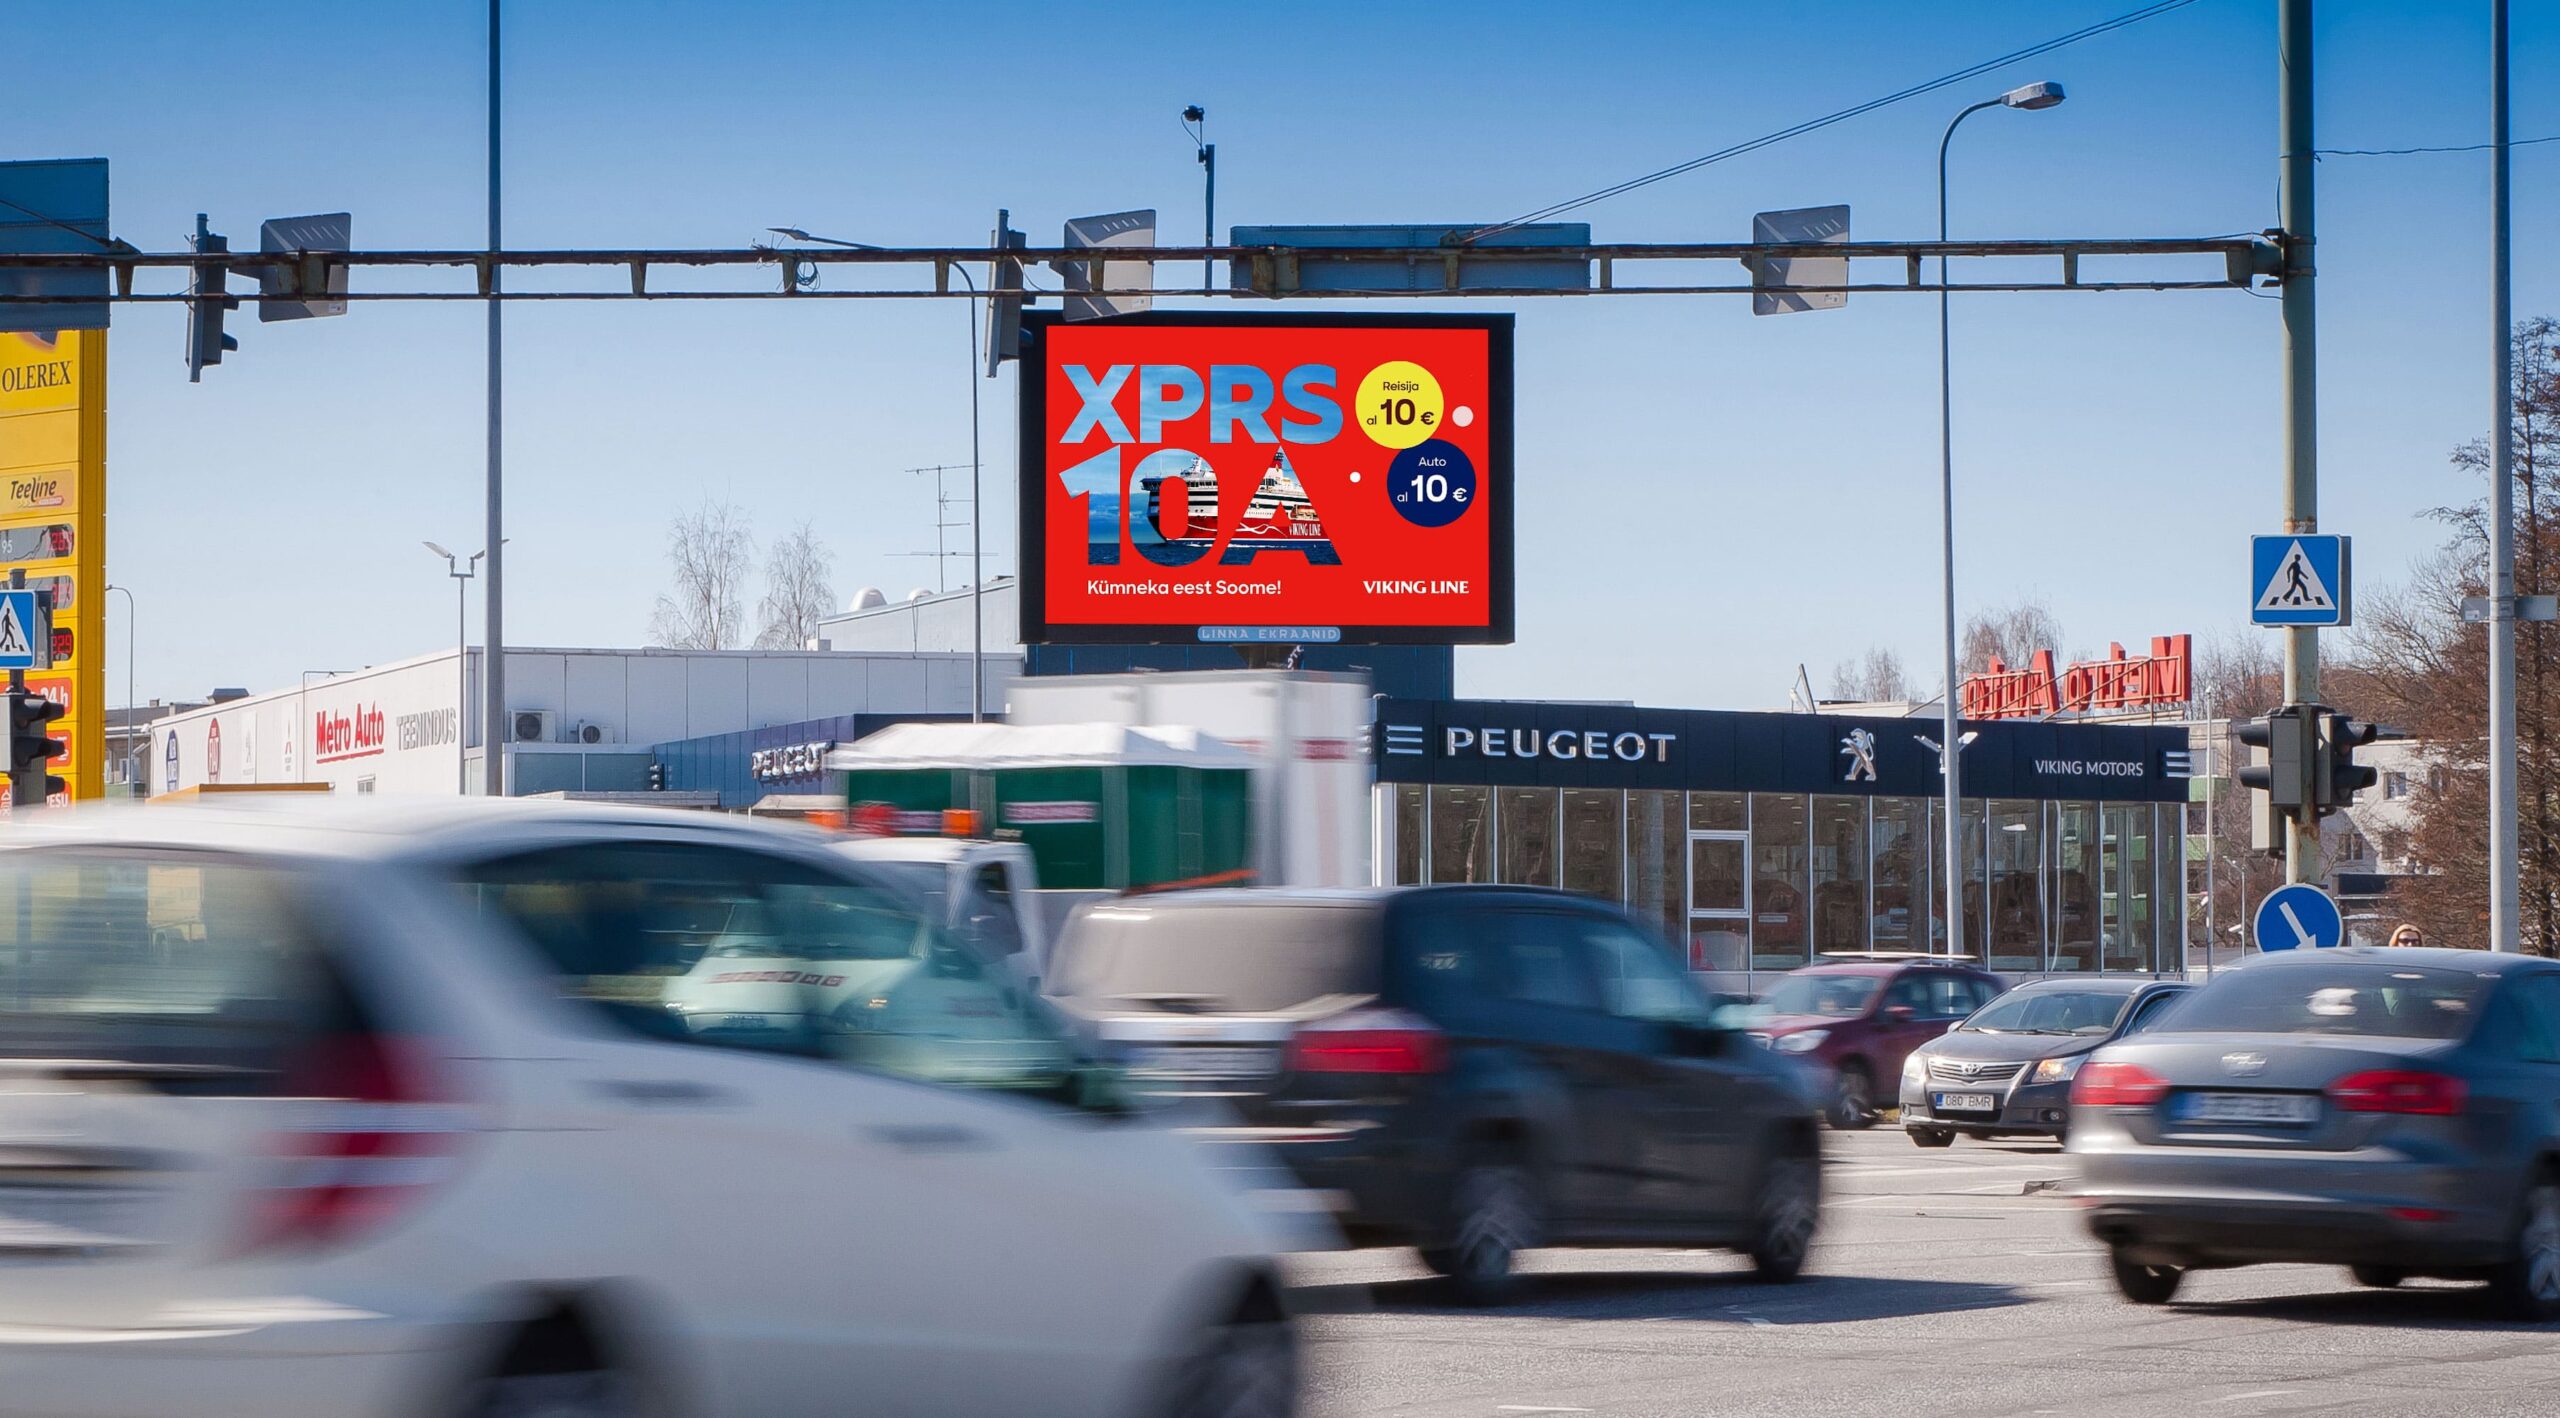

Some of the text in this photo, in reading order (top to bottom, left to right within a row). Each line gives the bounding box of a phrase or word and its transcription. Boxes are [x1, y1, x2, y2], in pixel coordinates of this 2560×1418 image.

[2, 360, 73, 393] OLEREX
[1383, 381, 1419, 393] Reisija
[1059, 364, 1344, 444] XPRS
[1366, 398, 1435, 426] al 10 €
[1418, 456, 1447, 467] Auto
[11, 475, 57, 502] Teeline
[1397, 474, 1467, 503] al 10 €
[1059, 444, 1344, 567] 10A
[1, 539, 13, 554] 95
[1087, 579, 1282, 595] Kümneka eest Soome!
[1363, 580, 1470, 594] VIKING LINE
[1202, 629, 1338, 640] LINNA EKRAANID
[316, 700, 385, 755] Metro Auto
[396, 707, 457, 751] TEENINDUS
[1447, 727, 1677, 762] PEUGEOT
[2035, 760, 2144, 777] VIKING MOTORS
